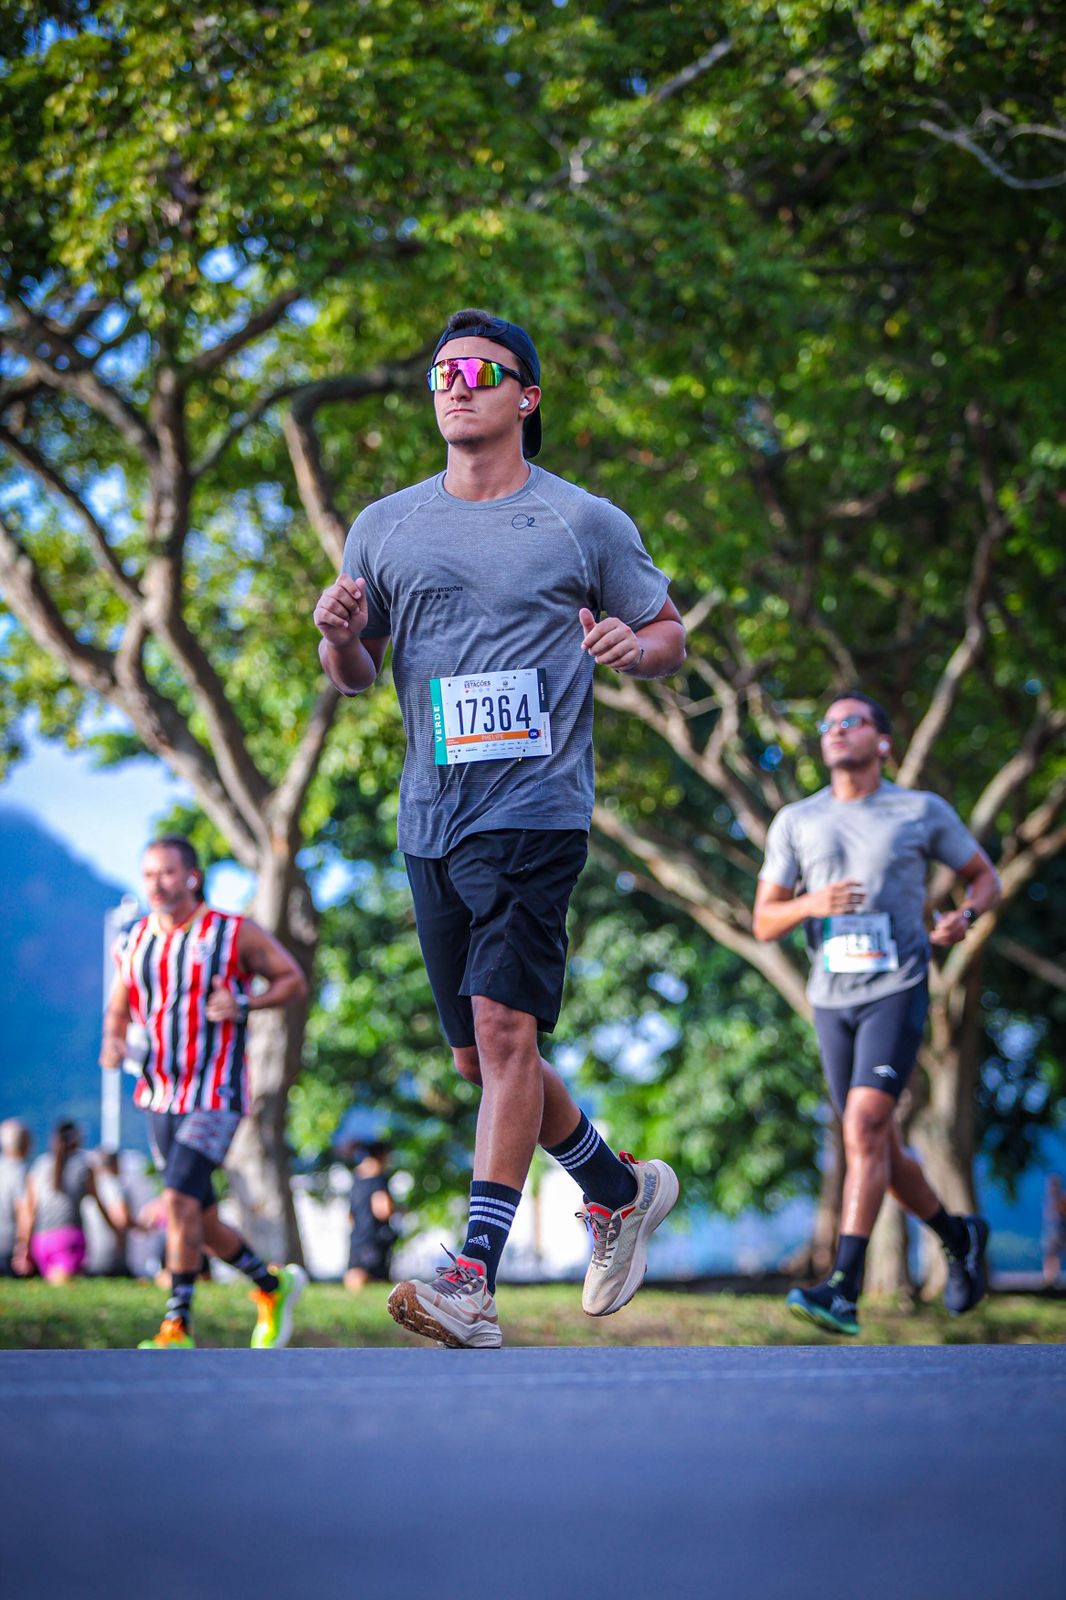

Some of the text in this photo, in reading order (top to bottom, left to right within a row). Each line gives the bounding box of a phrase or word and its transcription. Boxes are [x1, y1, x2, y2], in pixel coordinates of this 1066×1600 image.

[464, 680, 491, 688] ESTAÇÕES
[434, 706, 442, 742] VERDE
[456, 693, 531, 735] 17364
[468, 1238, 491, 1251] adidas
